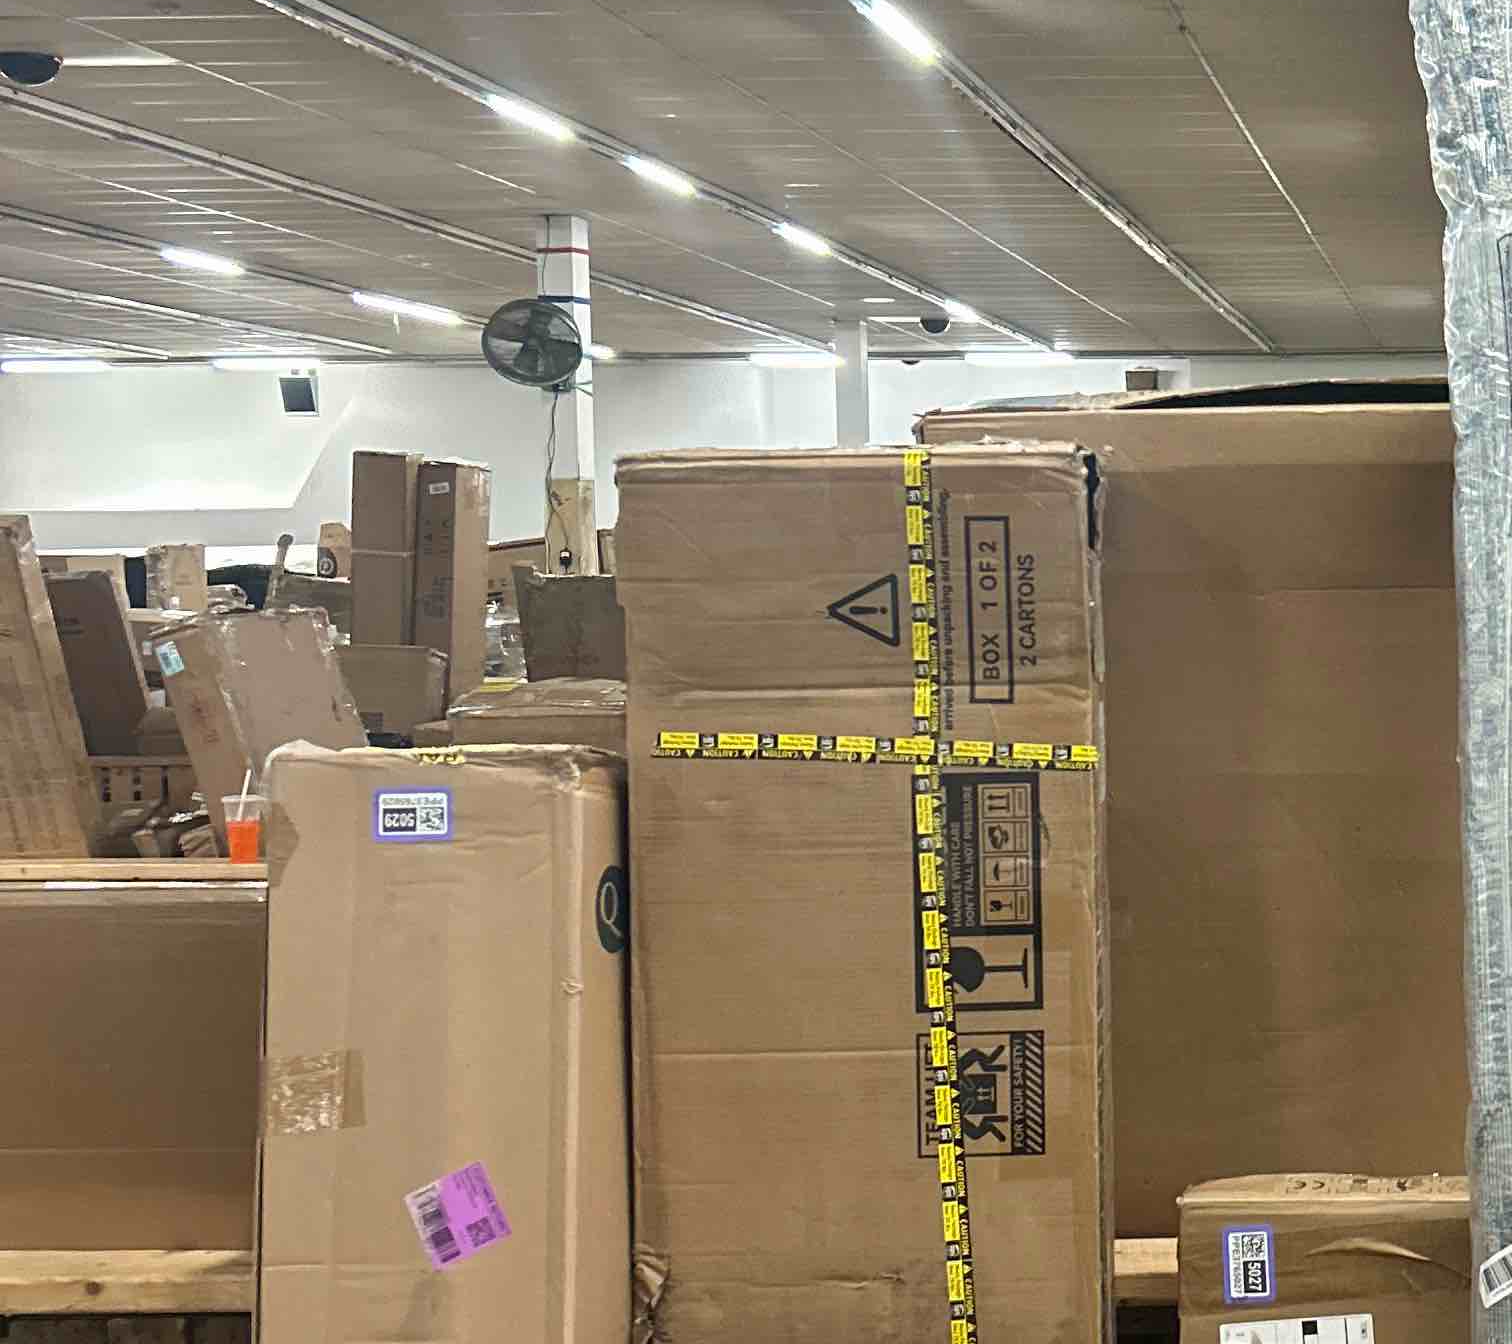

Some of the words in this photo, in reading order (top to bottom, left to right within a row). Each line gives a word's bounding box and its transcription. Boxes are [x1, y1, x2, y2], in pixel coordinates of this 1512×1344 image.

[979, 540, 997, 553] 2
[979, 560, 998, 592] OF
[980, 601, 998, 611] 1
[1017, 554, 1037, 650] CARTONS
[981, 634, 1000, 680] BOX
[1019, 655, 1037, 666] 2
[384, 812, 415, 828] 5029
[950, 822, 961, 851] CARE
[952, 884, 962, 927] HANDLE
[925, 1087, 938, 1147] TEAM
[1013, 1091, 1024, 1121] YOUR
[1013, 1123, 1024, 1148] FOR
[1248, 1262, 1267, 1291] 5027
